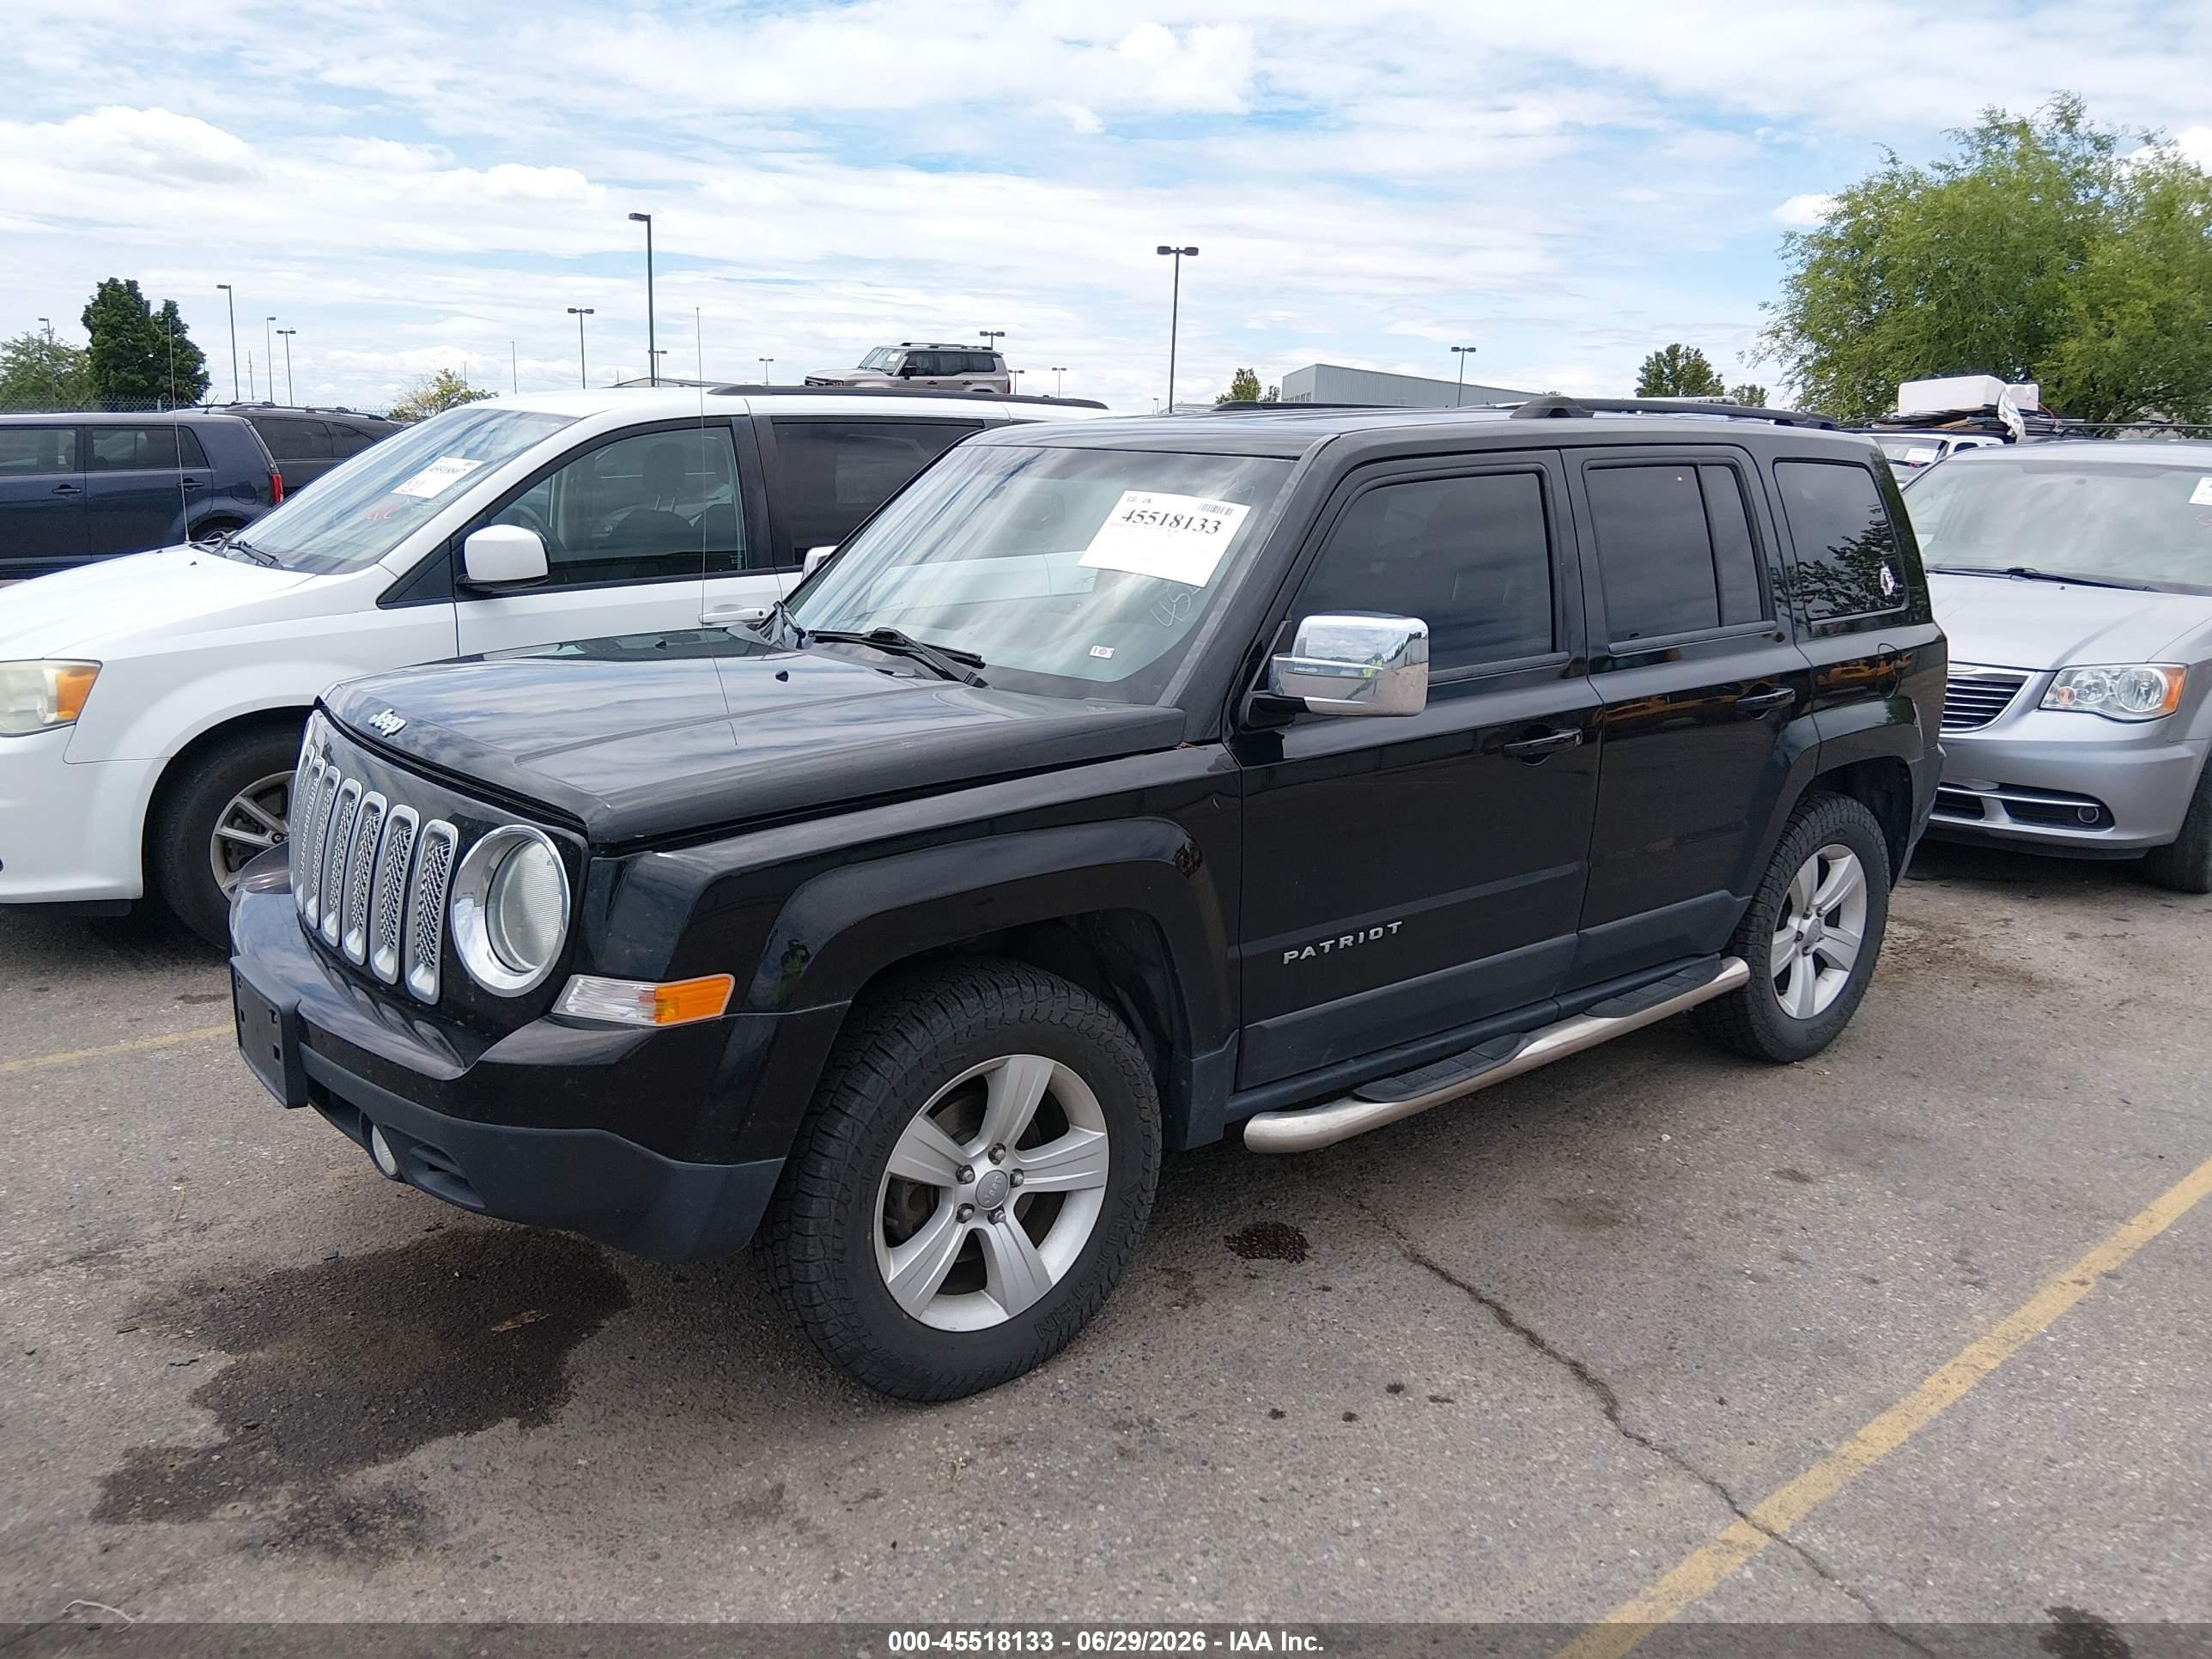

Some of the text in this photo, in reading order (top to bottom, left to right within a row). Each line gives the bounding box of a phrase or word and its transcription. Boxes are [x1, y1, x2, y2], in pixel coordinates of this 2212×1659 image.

[1121, 509, 1222, 535] 45518133
[368, 708, 406, 737] Jeep
[1282, 921, 1403, 964] PATRIOT
